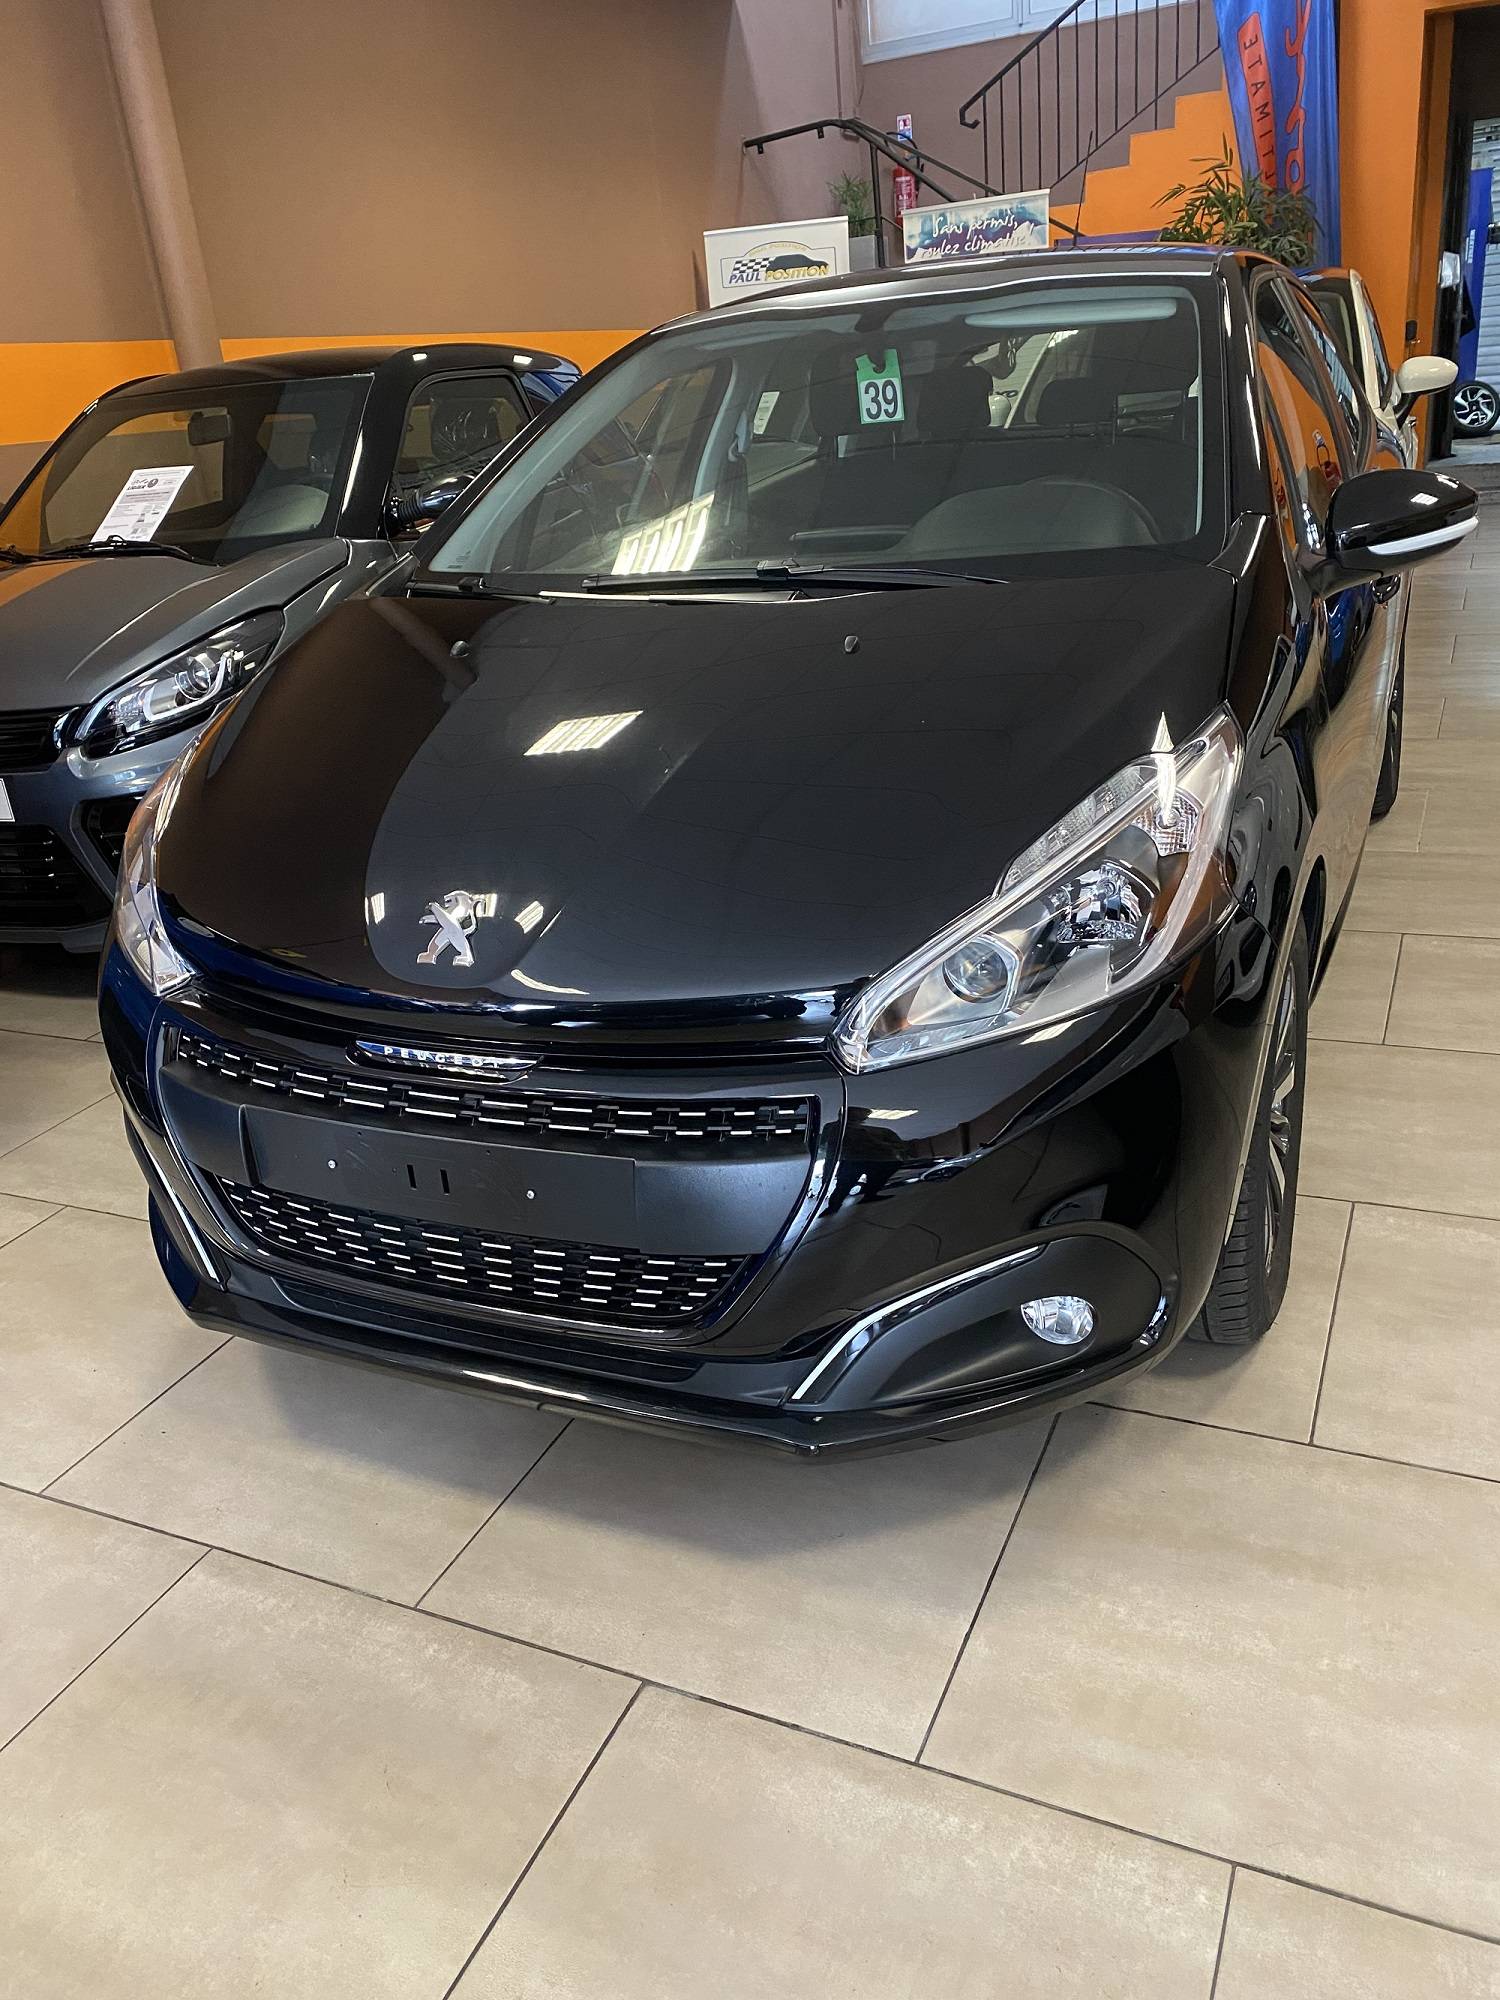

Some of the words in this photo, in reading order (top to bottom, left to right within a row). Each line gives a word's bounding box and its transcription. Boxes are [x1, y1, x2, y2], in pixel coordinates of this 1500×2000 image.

[932, 216, 965, 237] Sans
[921, 239, 960, 257] roulez
[729, 272, 761, 284] PAUL
[765, 265, 830, 281] POSITION
[864, 380, 899, 420] 39
[384, 1045, 500, 1068] PEUGEOT
